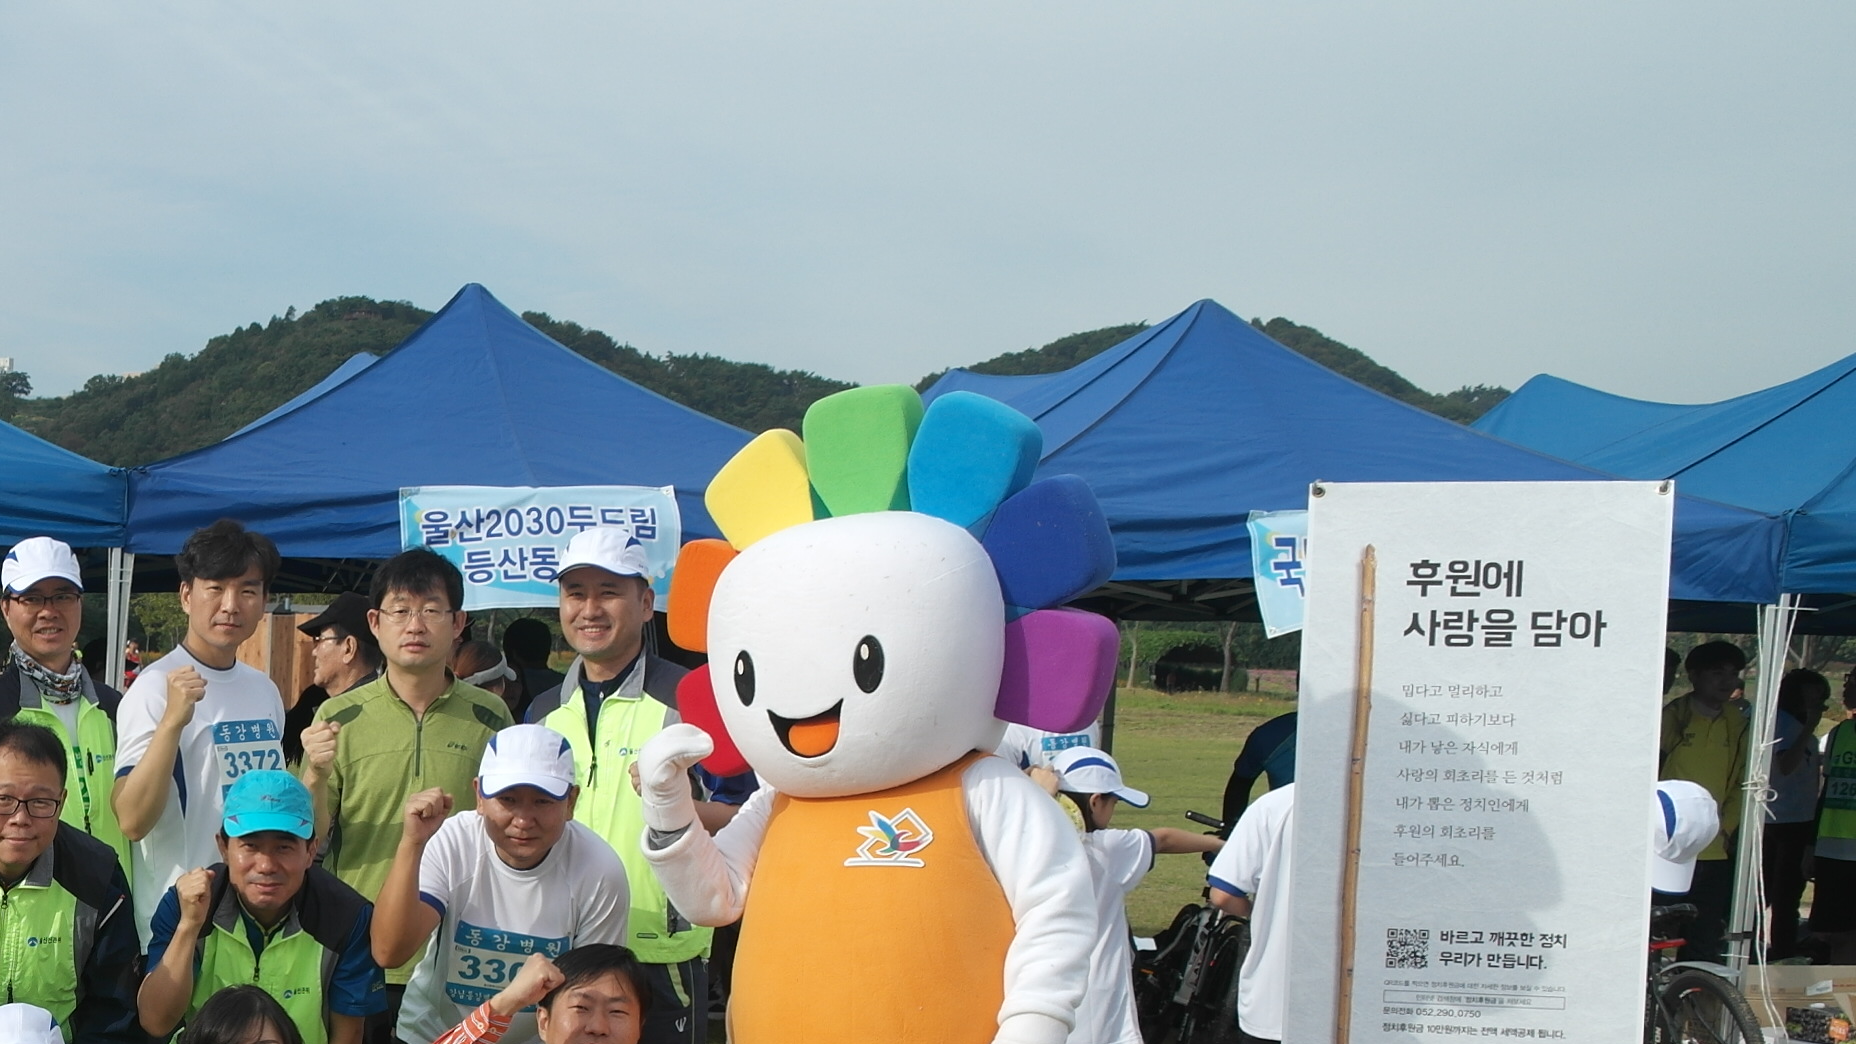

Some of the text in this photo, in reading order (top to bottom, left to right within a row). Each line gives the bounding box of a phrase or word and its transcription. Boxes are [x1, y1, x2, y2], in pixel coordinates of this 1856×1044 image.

[421, 505, 657, 545] 울산2030두드림
[1273, 537, 1307, 597] 국
[1406, 559, 1524, 598] 후원에
[1403, 608, 1607, 648] 사랑을 담아
[1402, 684, 1504, 699] 밉다고 멀리하고
[1400, 711, 1516, 728] 싫다고 피하기보다
[1398, 739, 1519, 756] 내가 낳은 자식에게
[224, 749, 283, 778] 3372
[1396, 767, 1564, 785] 사랑의 회초리를 든 것처럼
[1396, 796, 1529, 813] 내가 뽑은 정치인에게
[1393, 824, 1496, 841] 후원의 회초리를
[1392, 852, 1464, 868] 들어주세요.
[1440, 930, 1567, 949] 바르고 깨끗한 정치
[1439, 952, 1547, 970] 우리가 만듭니다.
